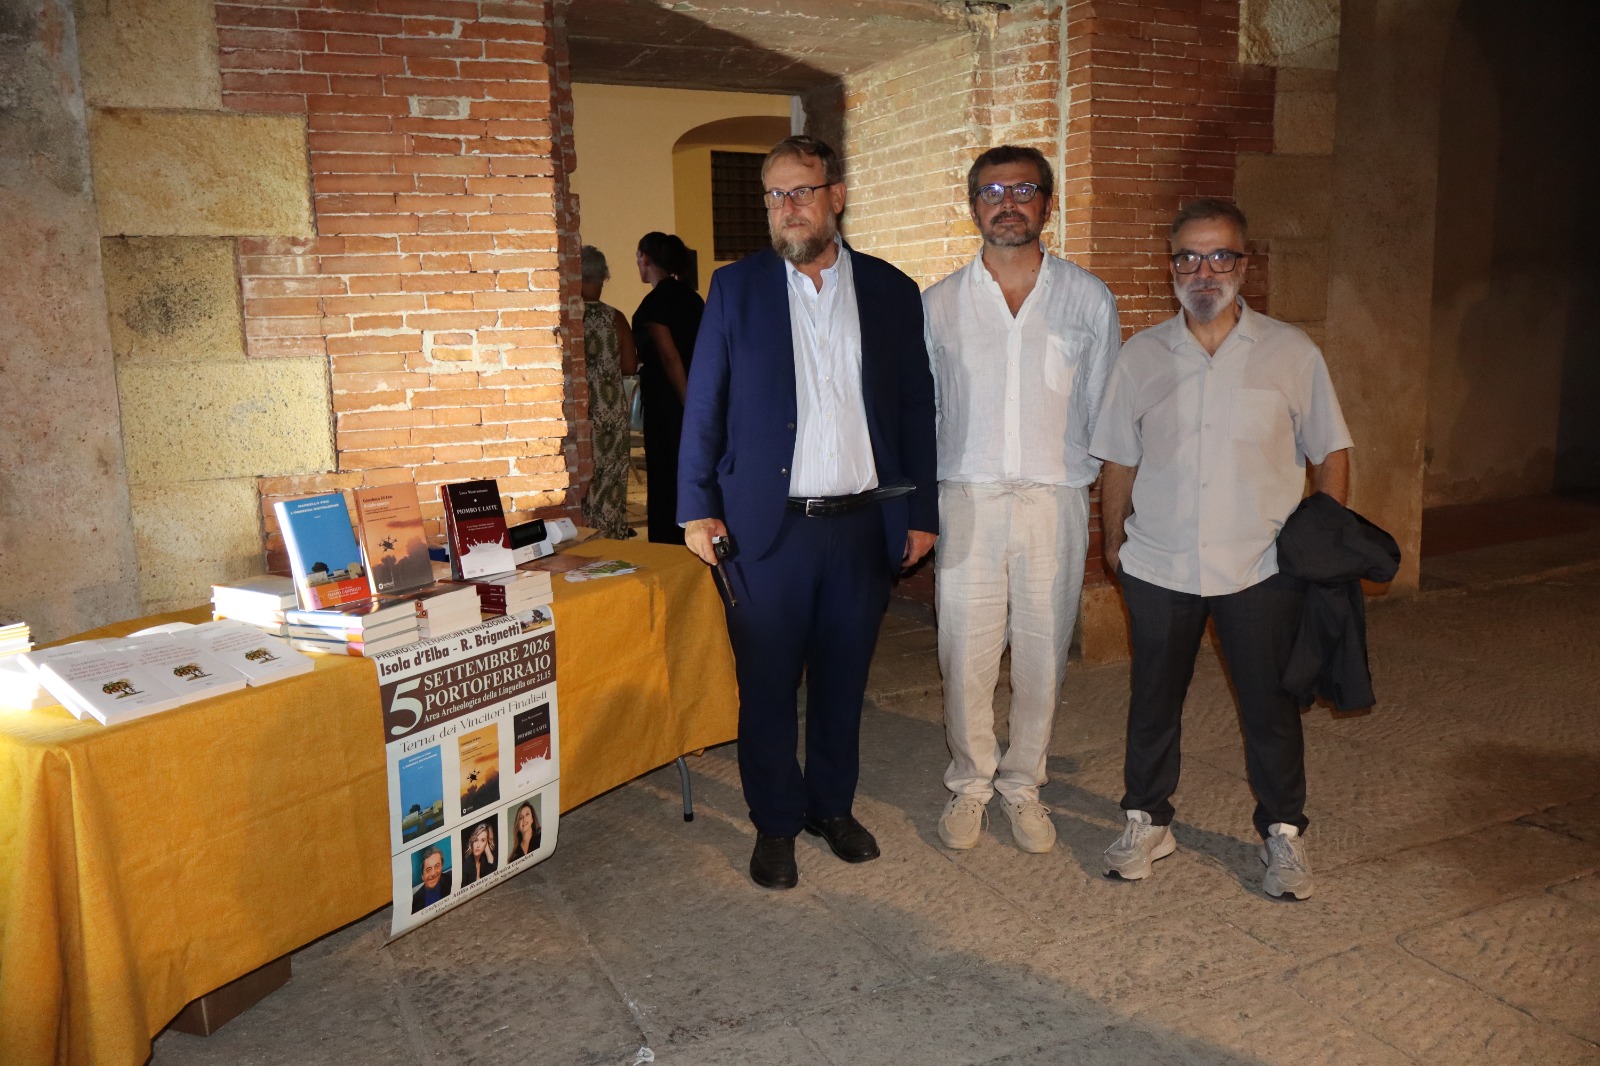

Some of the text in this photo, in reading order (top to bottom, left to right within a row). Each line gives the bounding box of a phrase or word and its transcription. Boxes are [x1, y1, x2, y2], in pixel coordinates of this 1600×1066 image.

[380, 658, 411, 677] Isola
[414, 644, 450, 667] d'Elba
[476, 622, 520, 648] Brignetti
[424, 635, 550, 692] SETTEMBRE 2026
[390, 677, 423, 736] 5
[425, 654, 551, 712] PORTOFERRAIO
[441, 697, 482, 717] Archeologica
[499, 679, 526, 697] Linguella
[400, 733, 435, 753] Terna
[439, 725, 457, 739] dei
[460, 707, 505, 730] Vincitori
[508, 690, 547, 713] Finalisti
